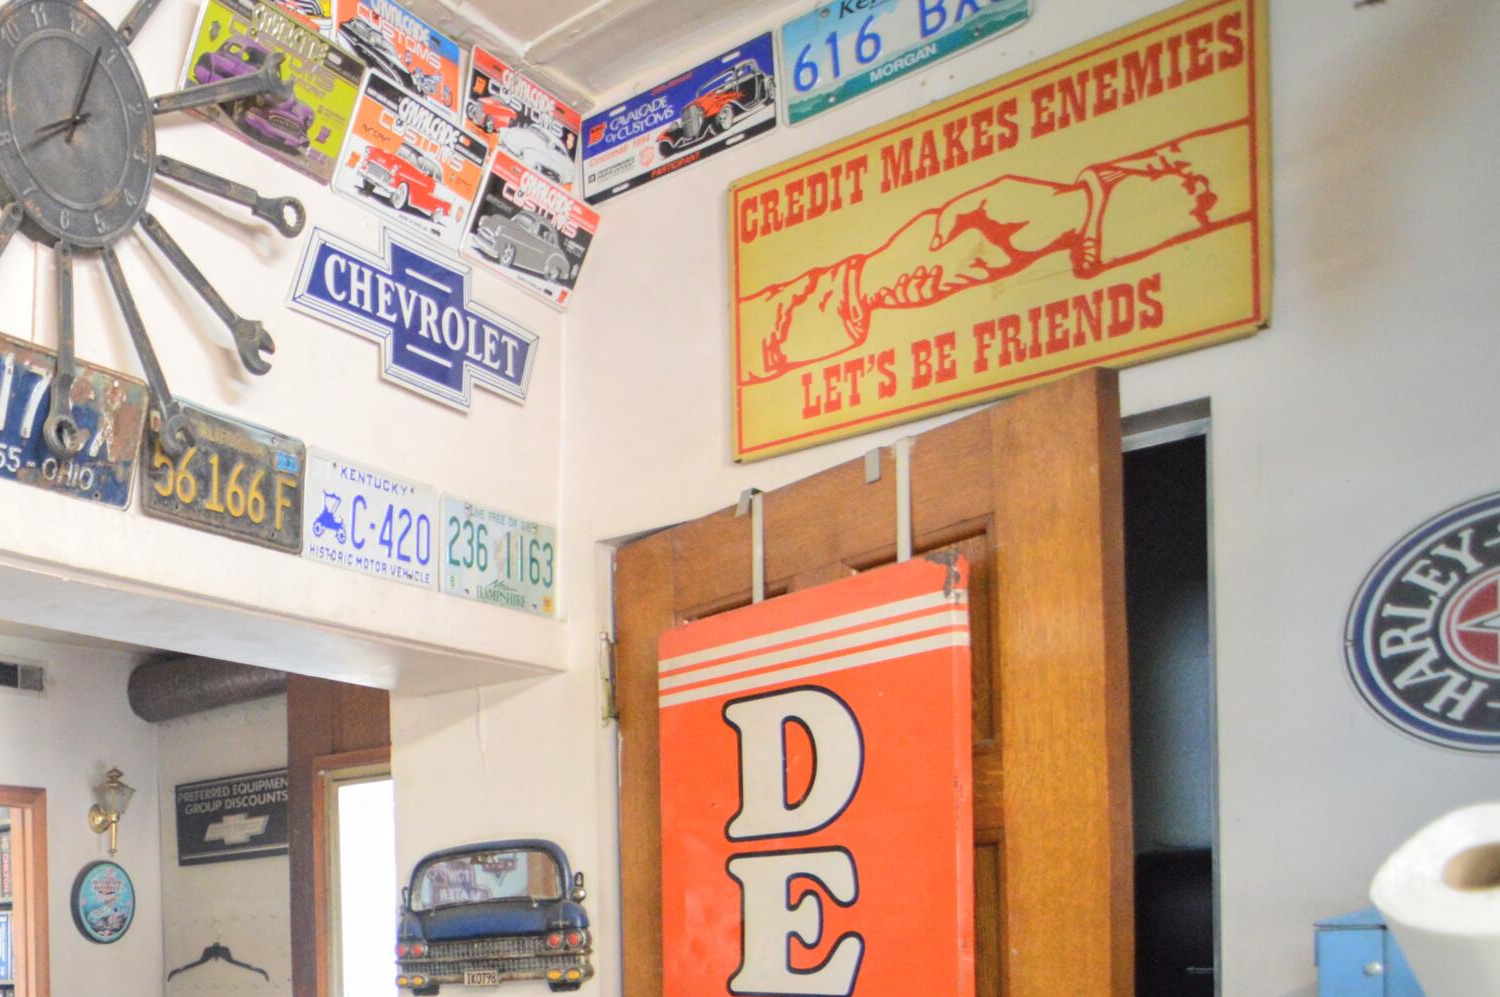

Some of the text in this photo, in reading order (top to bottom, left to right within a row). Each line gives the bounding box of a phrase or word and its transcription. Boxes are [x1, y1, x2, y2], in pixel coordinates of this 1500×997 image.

[0, 19, 22, 49] 10
[30, 3, 48, 28] 11
[356, 4, 442, 69] CUSTOMS
[793, 14, 882, 92] 616
[869, 43, 937, 83] MORGAN
[488, 78, 564, 138] CUSTOMS
[609, 95, 668, 131] CAVALCADE
[617, 105, 675, 141] CUSTOMS
[380, 110, 464, 172] CUSTOMS
[740, 15, 1245, 244] CREDIT MAKES ENEMIES
[650, 152, 699, 178] PARTICIPANT
[502, 182, 579, 239] CUSTOMS
[324, 253, 520, 379] CHEVROLET
[801, 274, 1163, 419] LET'S BE FRIENDS
[42, 457, 94, 490] OHIO
[340, 465, 409, 496] KENTUCKY
[351, 495, 430, 565] C-420
[488, 510, 507, 525] FREE
[448, 516, 488, 572] 236
[309, 545, 430, 584] HISTORIC MOTOR VEHICLE
[476, 585, 527, 609] HAMPSHIRE
[177, 777, 288, 803] PREFERRED EQUIPMEN
[185, 790, 289, 815] GROUP DISCOUNTS
